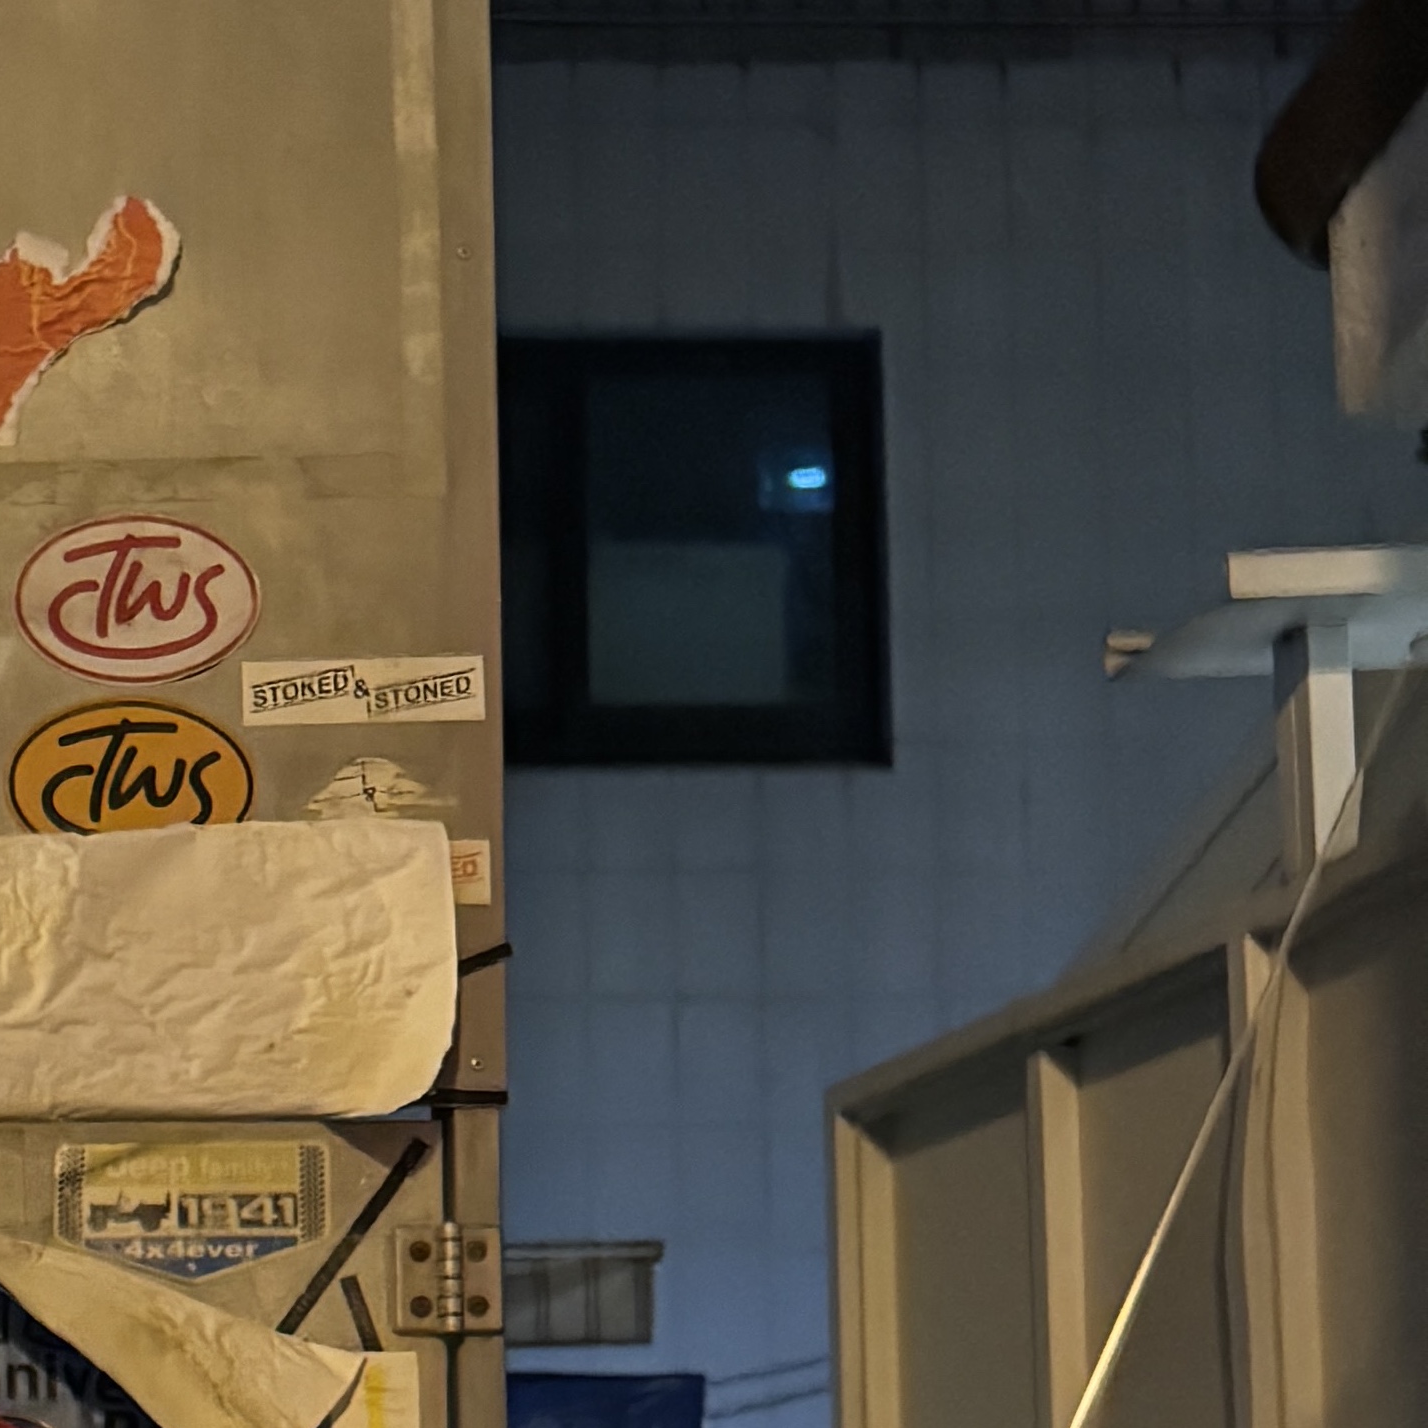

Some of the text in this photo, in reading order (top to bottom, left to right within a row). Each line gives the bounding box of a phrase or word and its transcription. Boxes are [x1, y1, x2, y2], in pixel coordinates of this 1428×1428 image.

[250, 671, 472, 713] STOKED & STONED
[123, 1240, 260, 1259] 4x4ever
